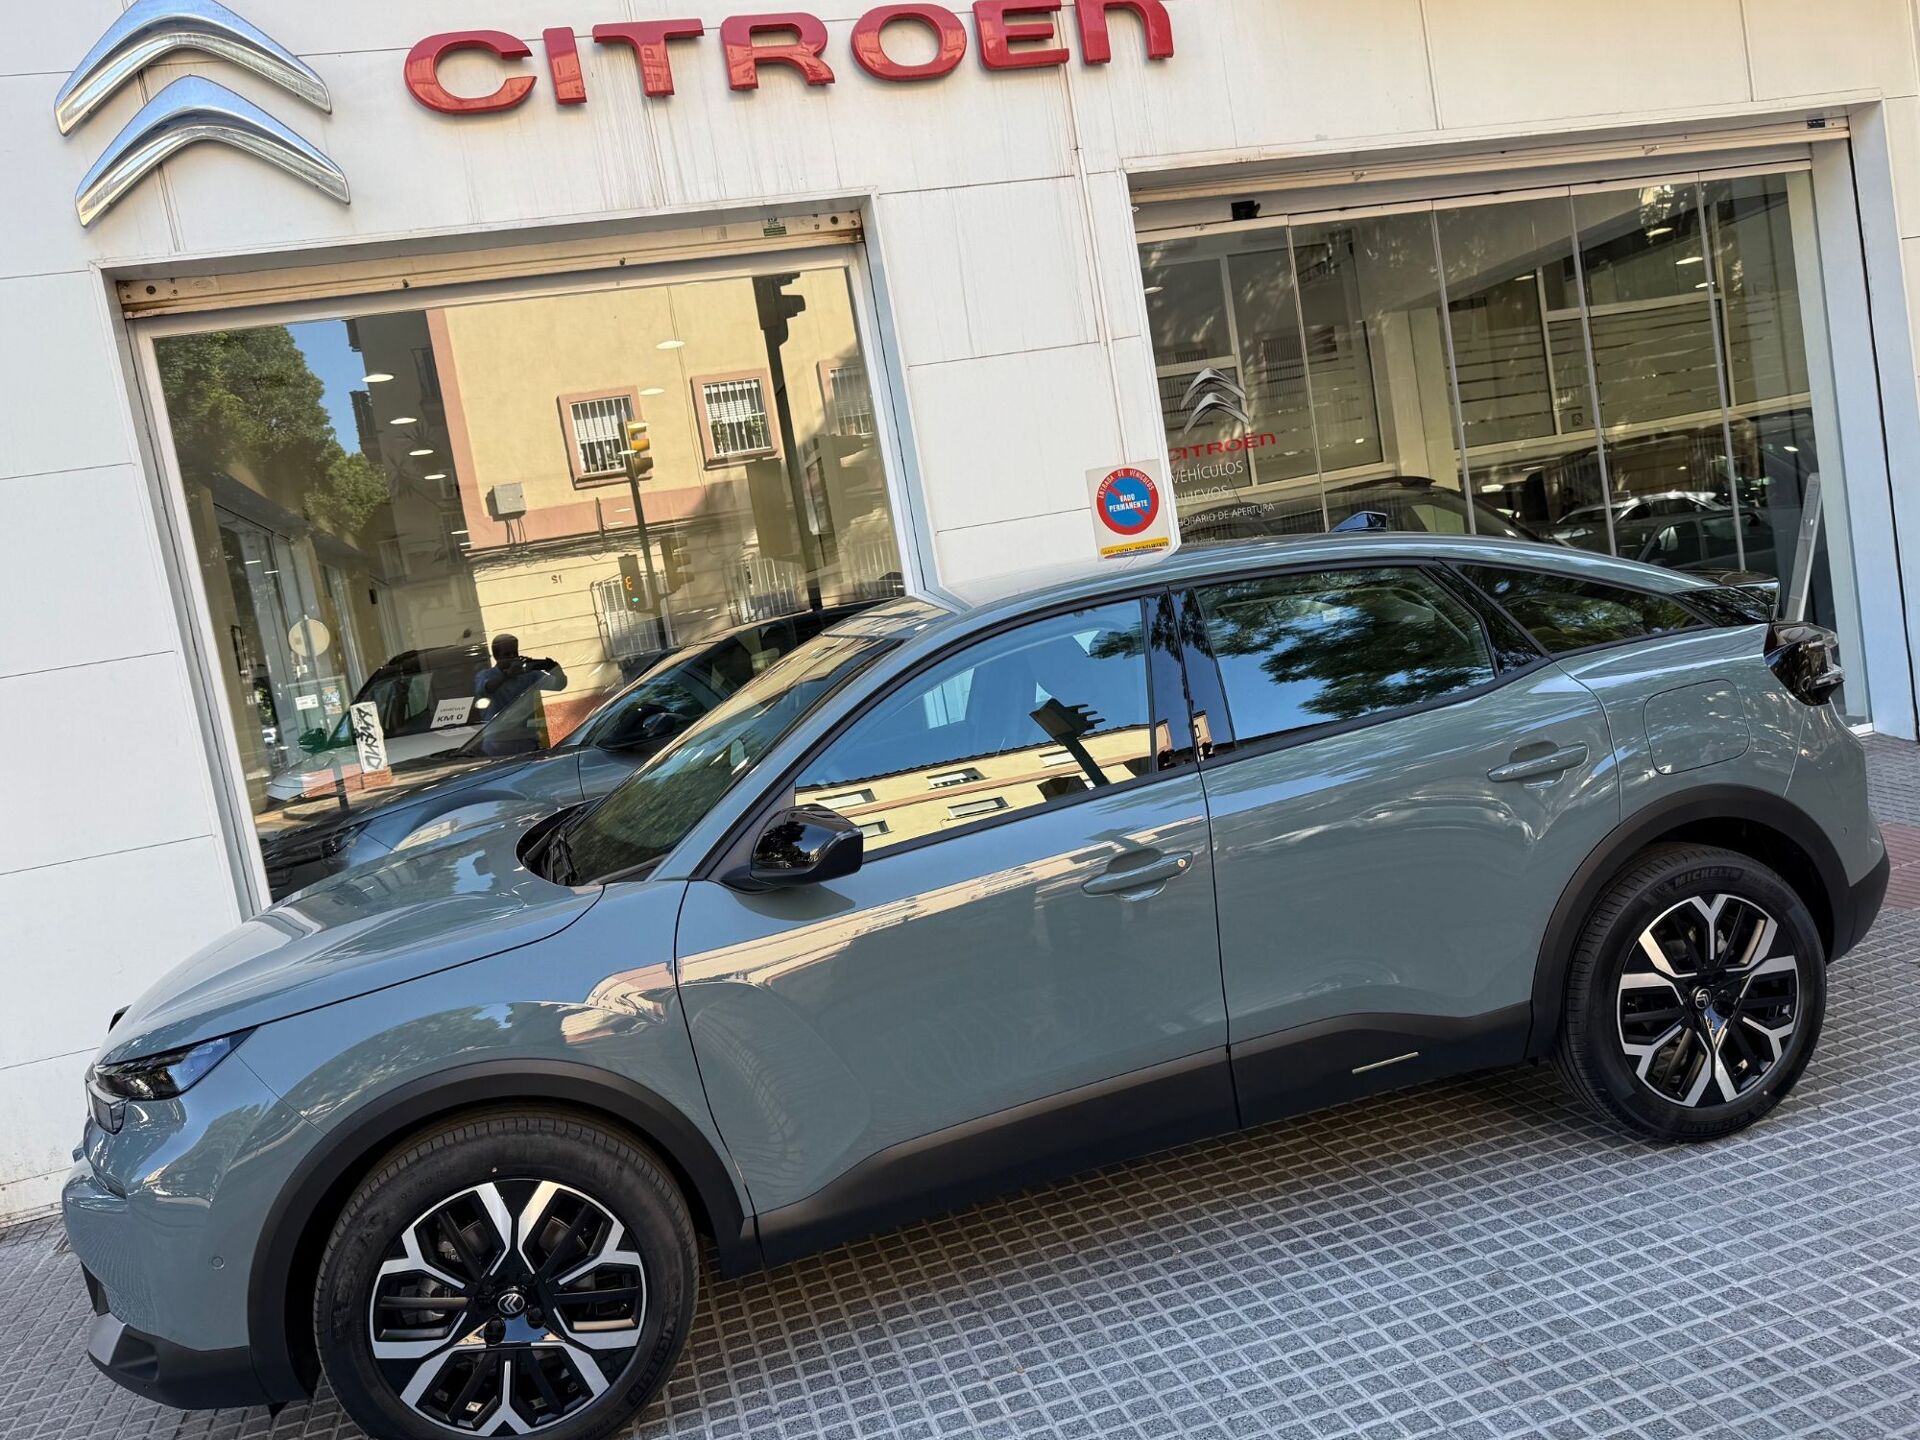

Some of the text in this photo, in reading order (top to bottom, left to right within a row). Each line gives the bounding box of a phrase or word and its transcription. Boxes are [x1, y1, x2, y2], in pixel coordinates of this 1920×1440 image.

[1098, 475, 1116, 499] ENTRADA
[1108, 499, 1149, 513] PERMANENTE
[1119, 493, 1136, 503] VADO
[1178, 502, 1276, 527] HORARIO DE APERTURA
[437, 714, 454, 722] KM
[1673, 866, 1742, 887] MICHELIN
